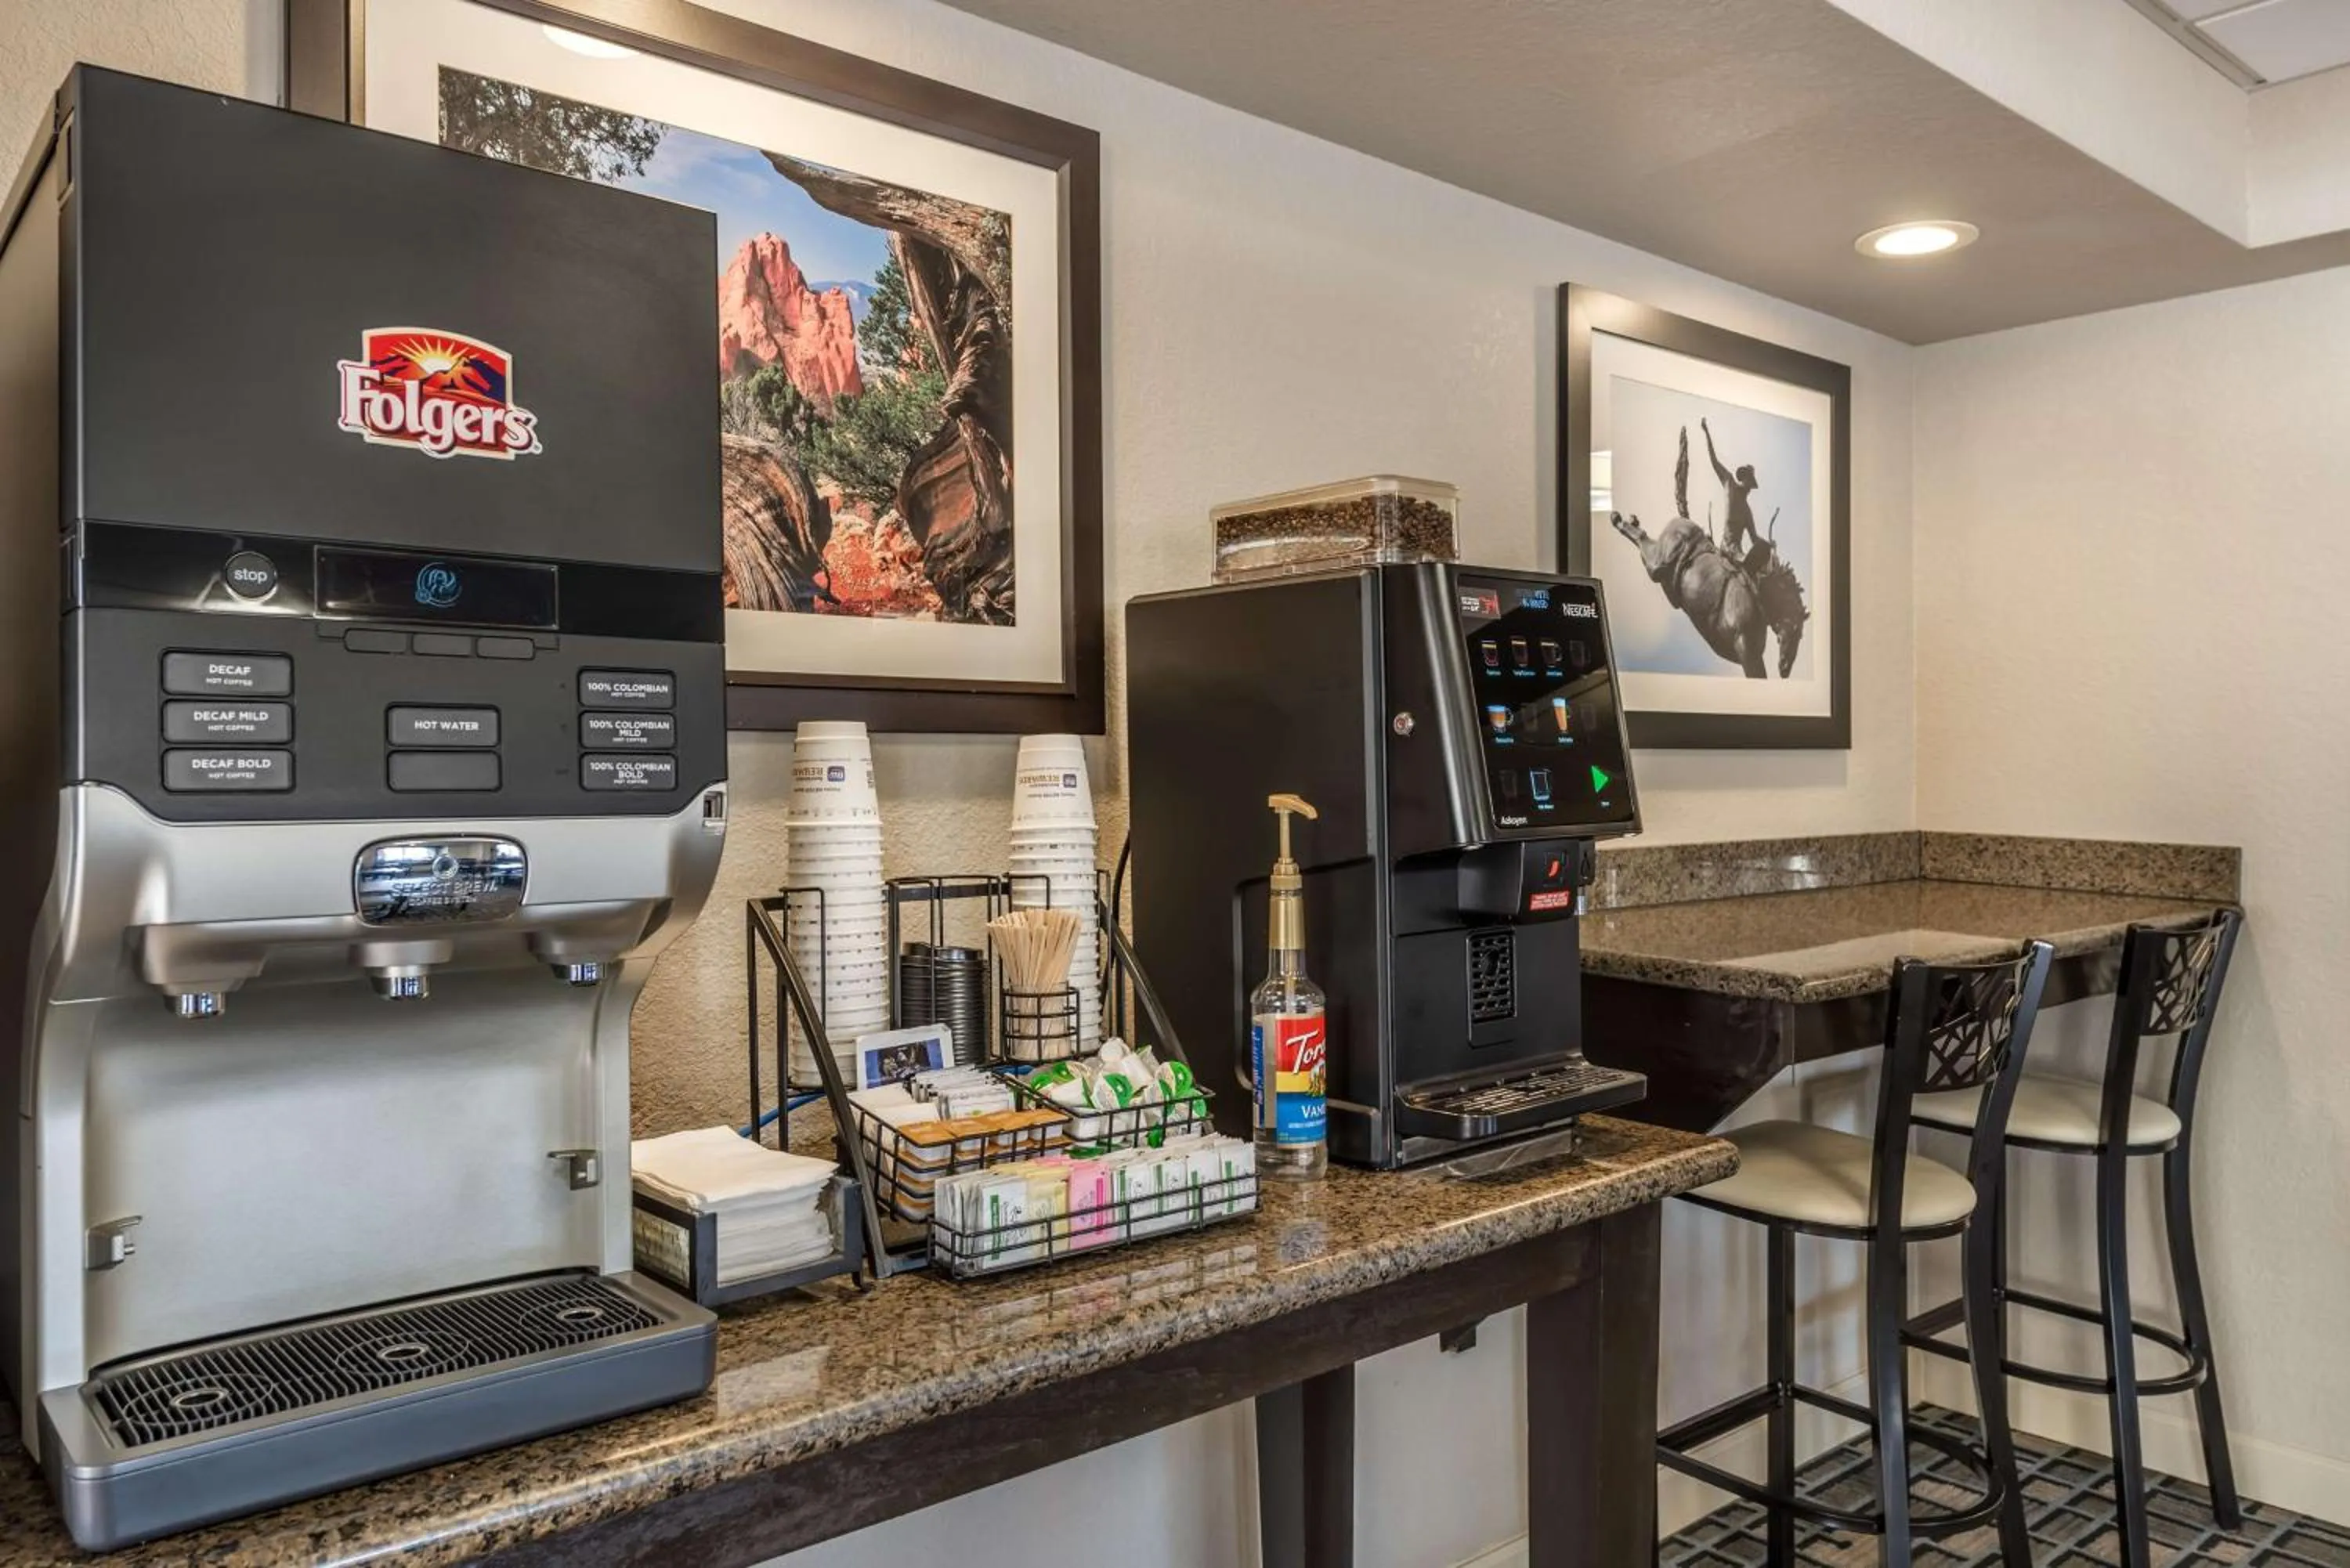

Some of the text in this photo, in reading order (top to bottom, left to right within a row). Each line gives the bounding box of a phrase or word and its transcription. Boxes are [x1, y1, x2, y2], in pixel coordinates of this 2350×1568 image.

[339, 363, 533, 452] Folgers
[234, 568, 268, 584] stop
[208, 663, 251, 675] DECAF
[588, 682, 668, 694] 100% COLOMBIAN
[193, 710, 269, 721] DECAF MILD
[414, 720, 479, 731] HOT WATER
[589, 720, 670, 730] 100% COLOMBIAN
[192, 758, 272, 769] DECAF BOLD
[590, 762, 671, 771] 100% COLOMBIAN
[618, 770, 644, 779] BOLD
